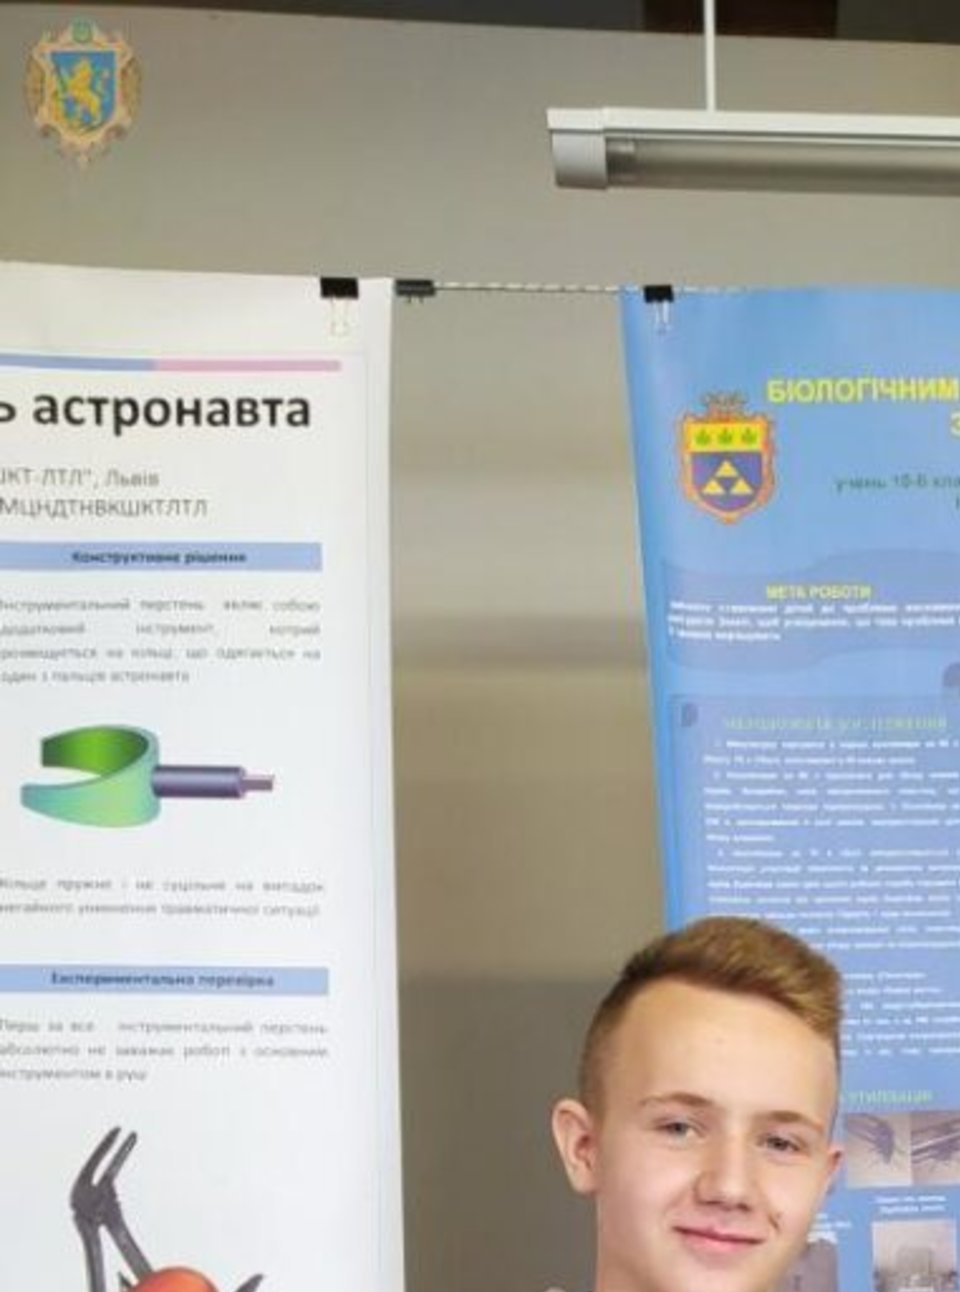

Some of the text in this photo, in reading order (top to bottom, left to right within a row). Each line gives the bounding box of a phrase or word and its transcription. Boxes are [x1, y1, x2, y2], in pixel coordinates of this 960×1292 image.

[767, 377, 960, 403] БІОЛОГІЧНИМ
[33, 394, 311, 437] астронавта
[809, 584, 872, 599] РОБОТИ
